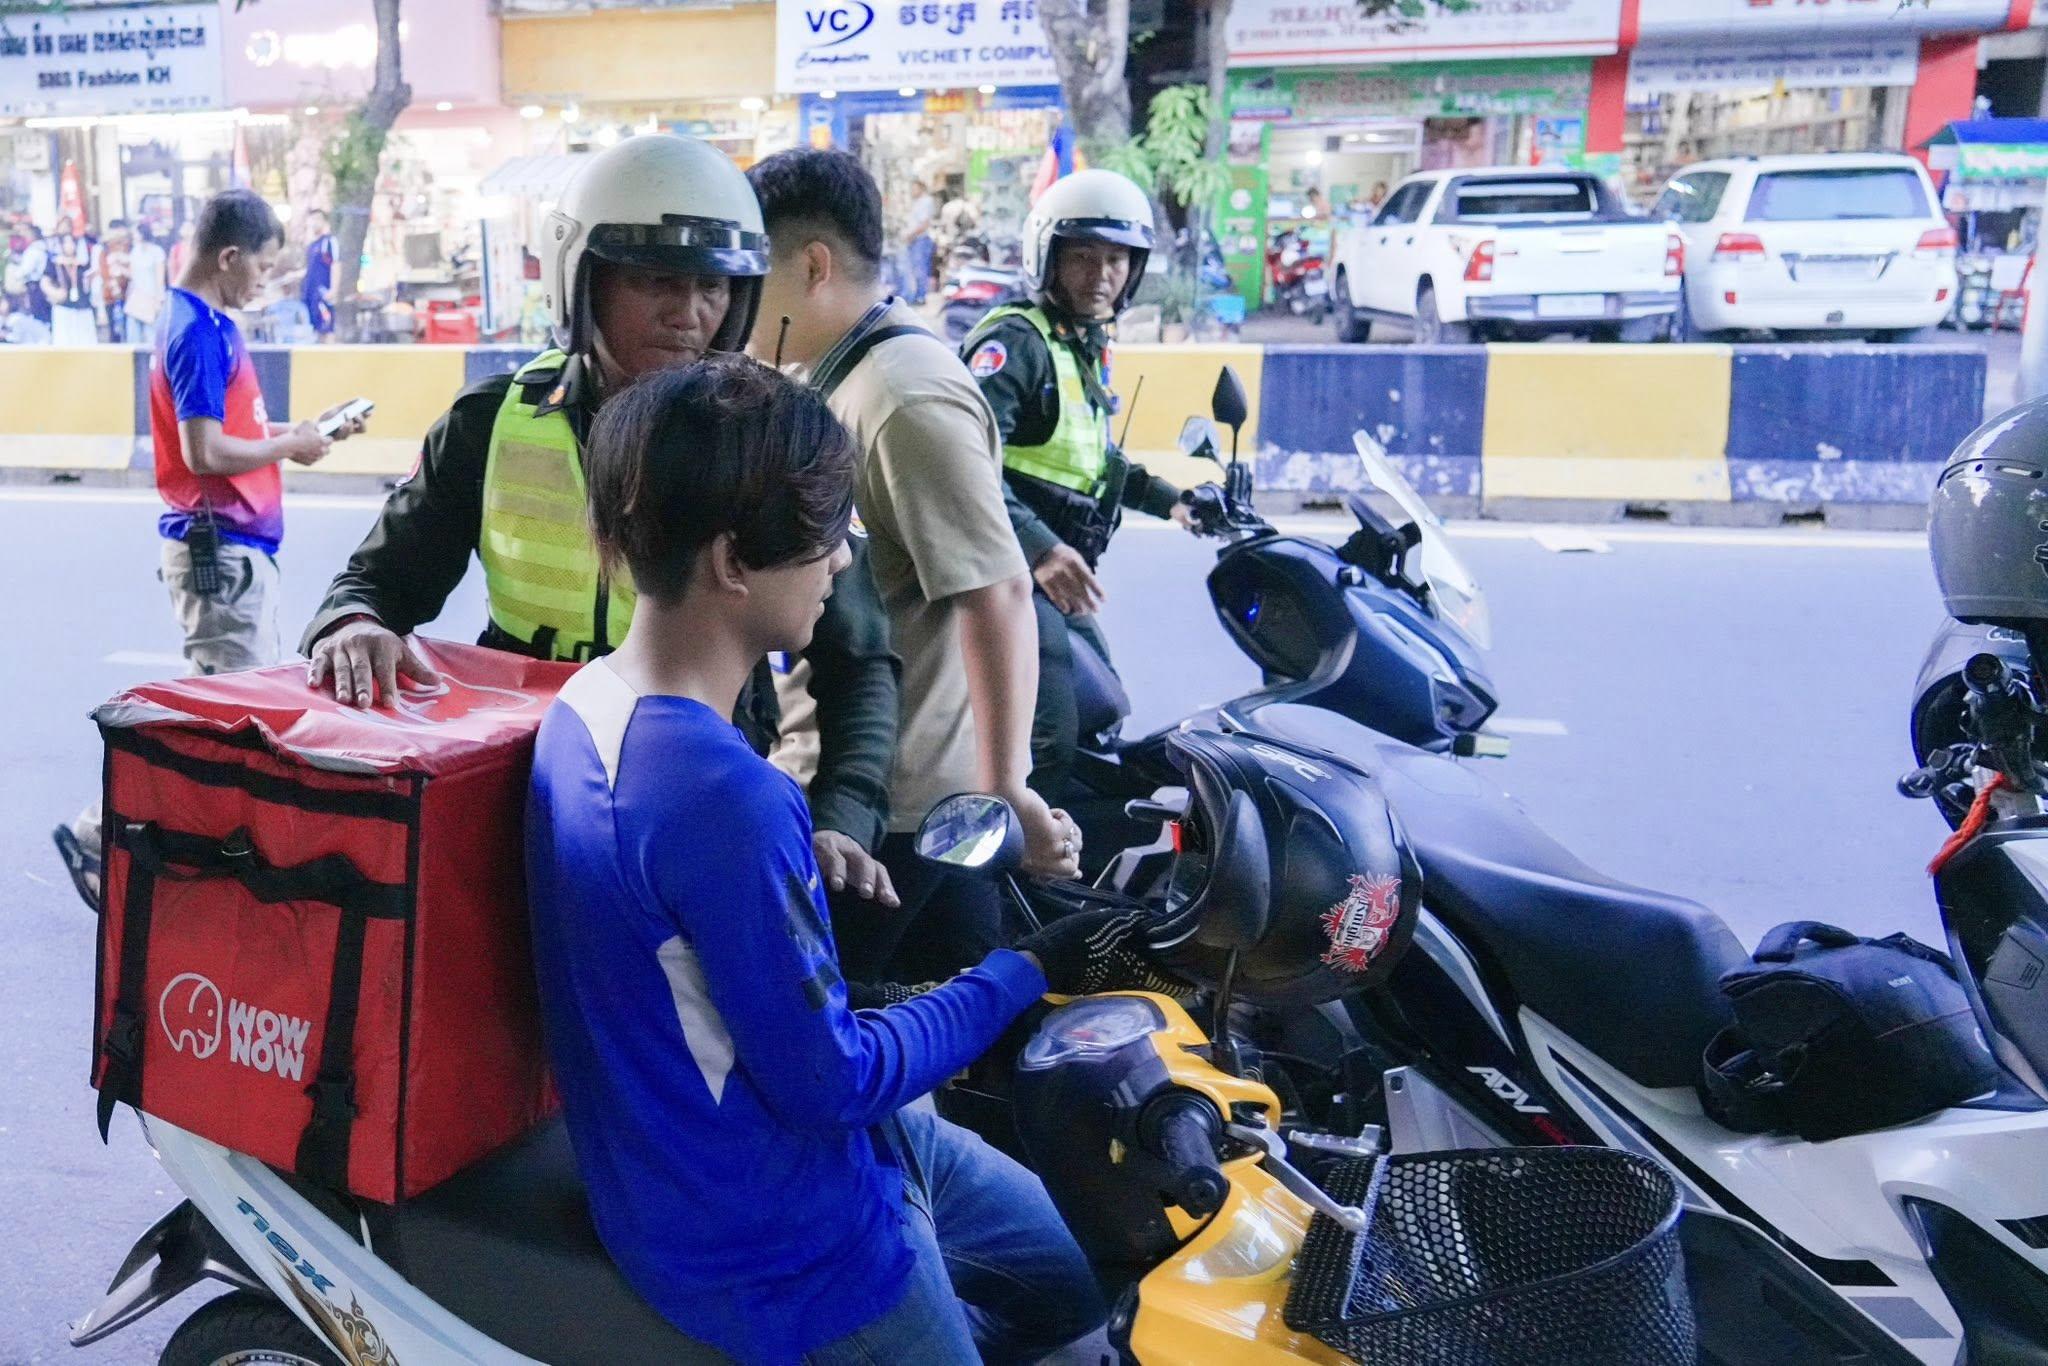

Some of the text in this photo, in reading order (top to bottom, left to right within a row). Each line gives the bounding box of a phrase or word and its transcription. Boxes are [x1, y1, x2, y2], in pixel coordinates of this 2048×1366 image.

[806, 9, 849, 32] VC
[898, 48, 972, 65] VICHET
[78, 69, 140, 87] Fashion
[148, 66, 171, 83] KH
[228, 998, 311, 1054] WOW
[230, 1032, 304, 1082] NOW
[1465, 1066, 1550, 1114] ADV
